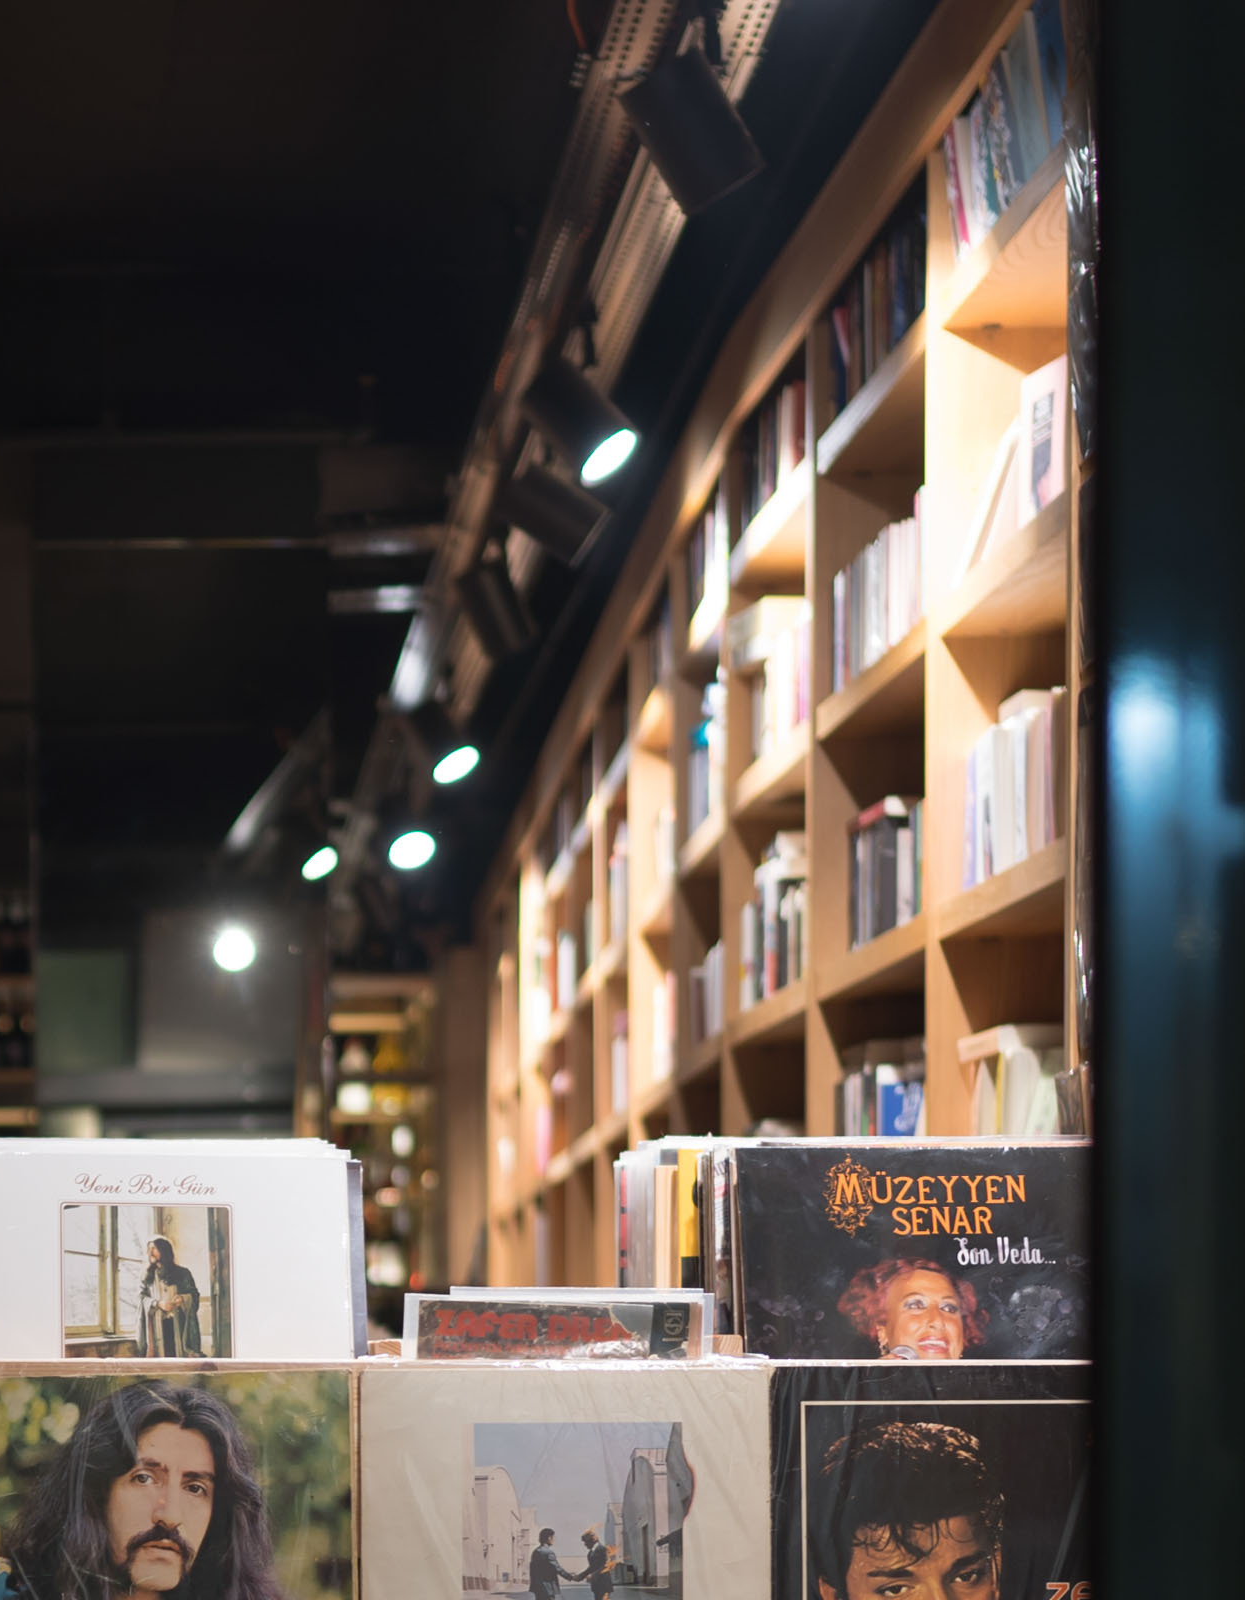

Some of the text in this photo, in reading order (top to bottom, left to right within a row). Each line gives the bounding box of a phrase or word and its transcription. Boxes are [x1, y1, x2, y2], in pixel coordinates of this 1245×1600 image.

[74, 1172, 217, 1196] Yeni Bir Gün
[833, 1170, 1027, 1205] MÜZEYYEN
[891, 1205, 994, 1236] SENAR
[953, 1236, 995, 1266] Son
[434, 1309, 538, 1340] ZAFER
